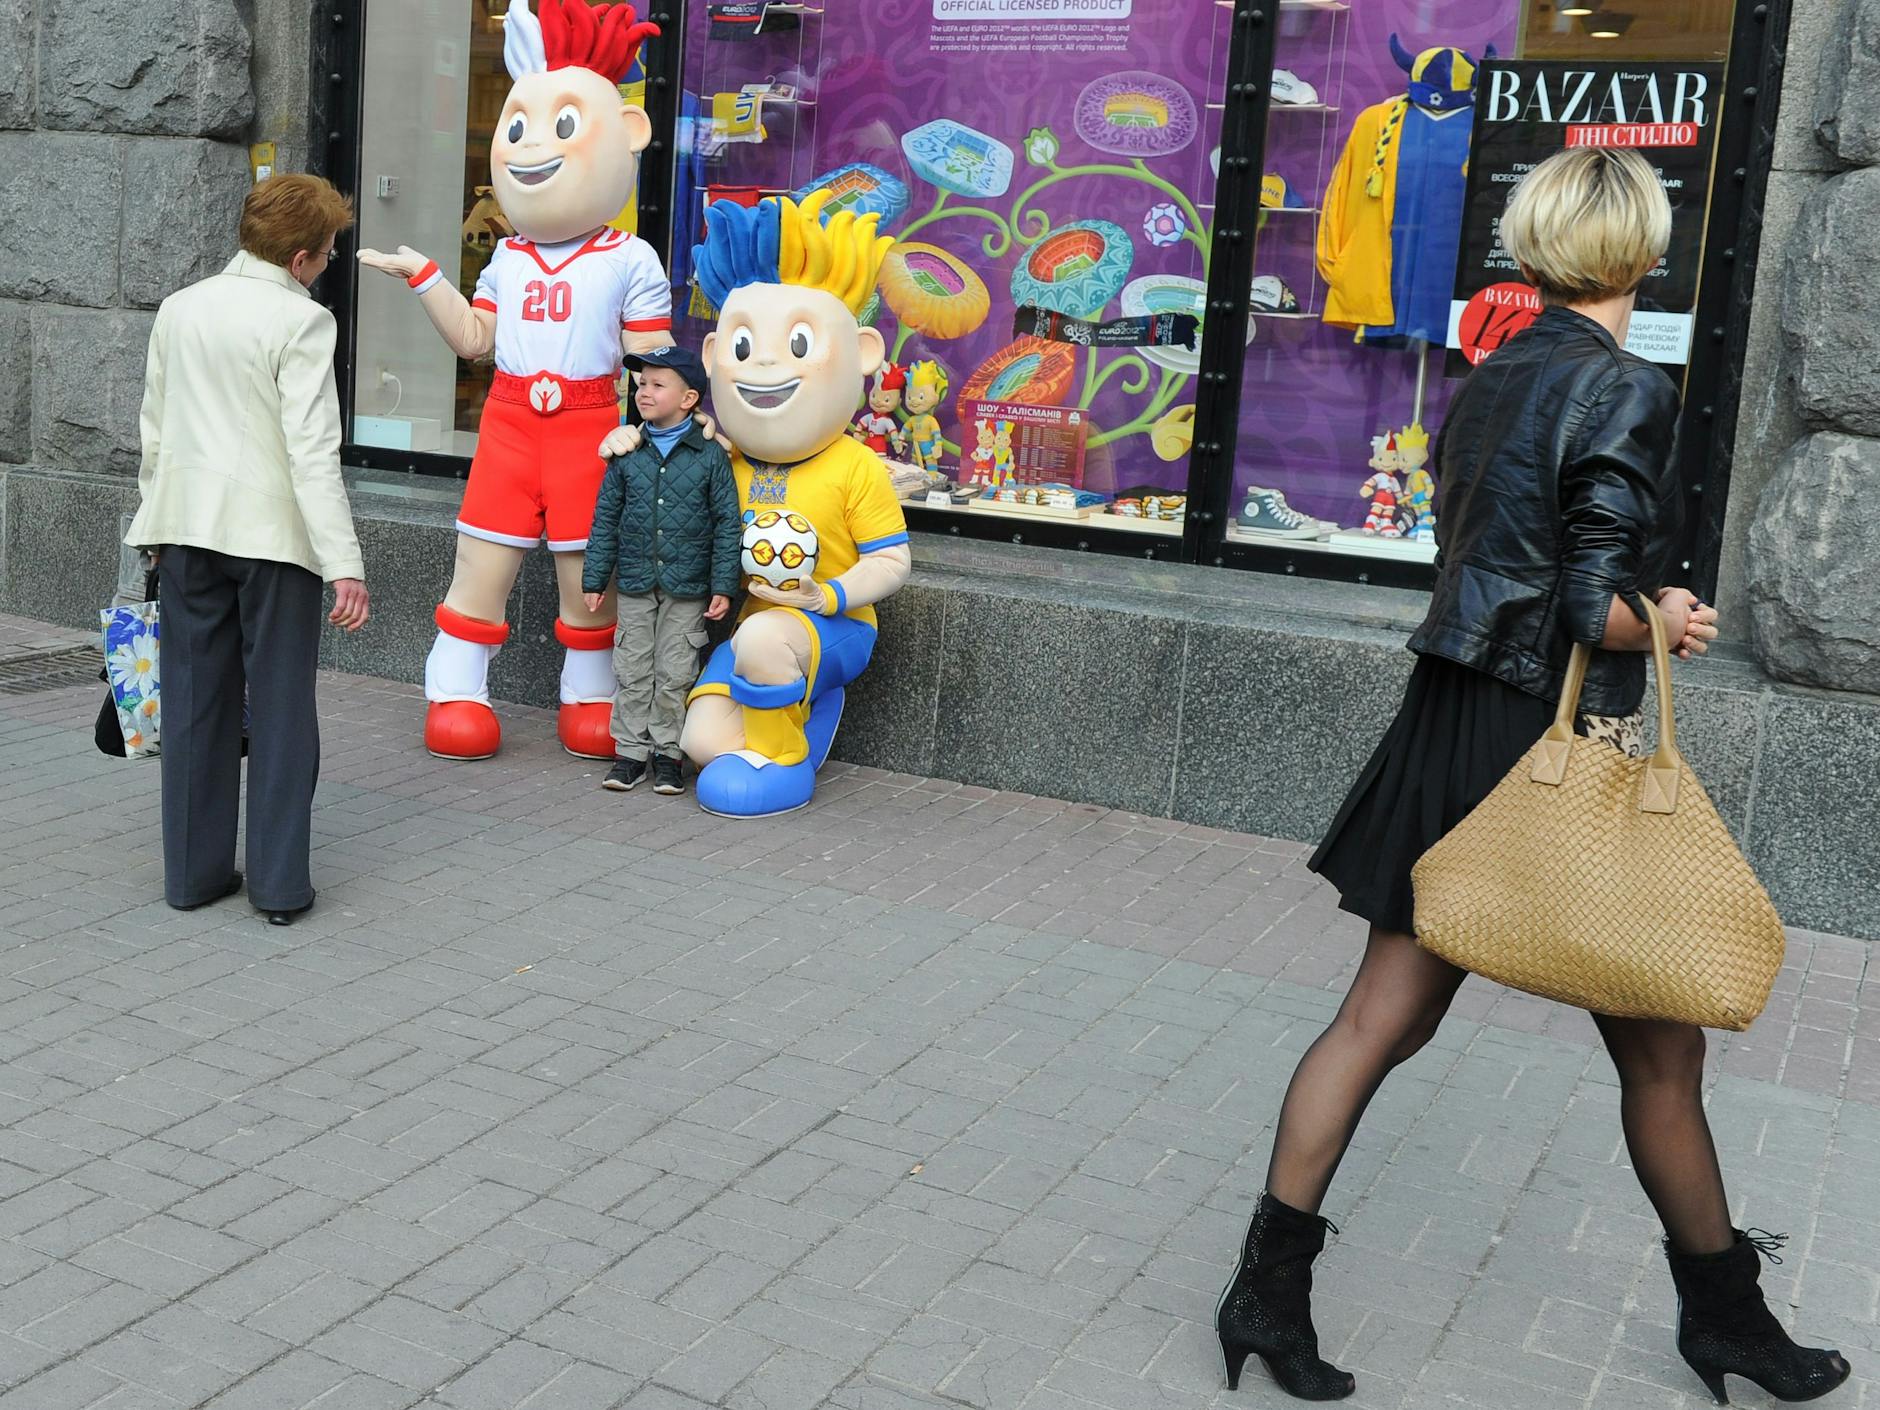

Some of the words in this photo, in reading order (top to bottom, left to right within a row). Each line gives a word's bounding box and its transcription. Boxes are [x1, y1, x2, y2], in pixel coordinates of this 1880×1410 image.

[940, 0, 995, 12] OFFICIAL
[999, 0, 1060, 11] LICENSED
[1063, 0, 1125, 10] PRODUCT
[931, 24, 942, 32] The
[1042, 24, 1059, 32] UEFA
[1060, 24, 1078, 32] EURO
[1100, 24, 1116, 33] Logo
[1117, 24, 1130, 32] and
[999, 34, 1029, 42] European
[1058, 34, 1104, 42] Championship
[1106, 34, 1128, 42] Trophy
[940, 44, 971, 52] protected
[972, 44, 980, 52] by
[1075, 44, 1095, 52] rights
[1484, 70, 1710, 127] BAZAAR
[1571, 126, 1608, 148] ДНІ
[1612, 125, 1692, 146] СТИЛЮ
[1483, 260, 1496, 268] ЗА
[521, 280, 572, 322] 20
[977, 403, 1000, 413] ШОУ
[1006, 406, 1062, 419] ТАЛІСМАНІВ
